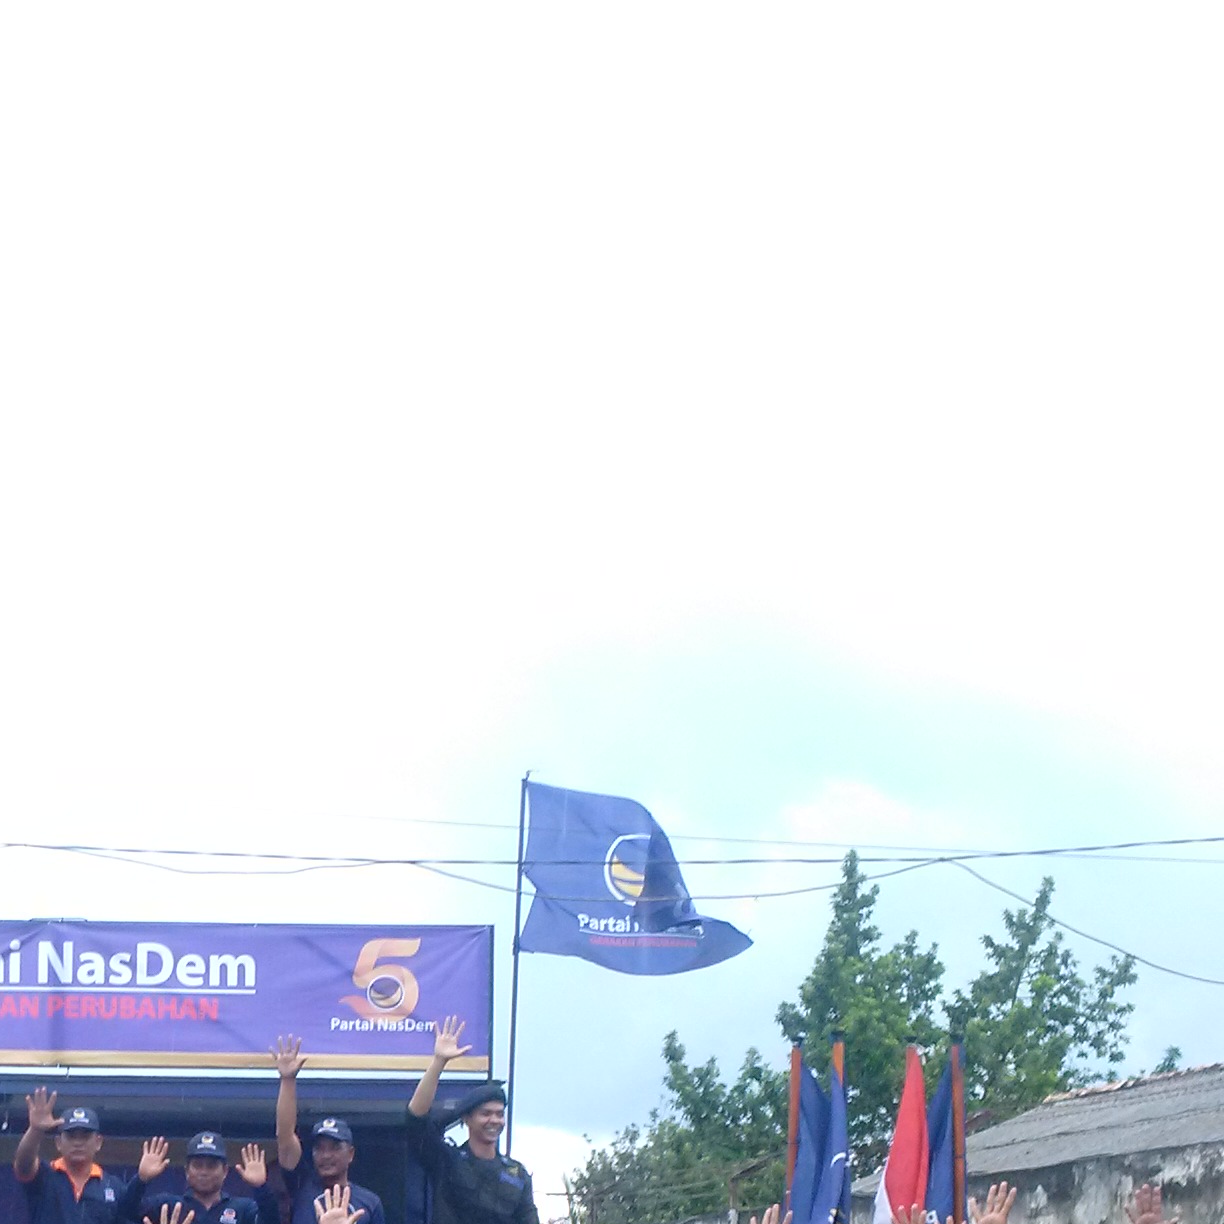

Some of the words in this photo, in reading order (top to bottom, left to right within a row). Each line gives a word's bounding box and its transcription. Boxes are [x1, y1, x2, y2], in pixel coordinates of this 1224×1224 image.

[577, 913, 631, 932] Partai
[37, 940, 256, 988] NasDem
[46, 996, 219, 1021] PERUBAHAN
[330, 1017, 374, 1032] Partai
